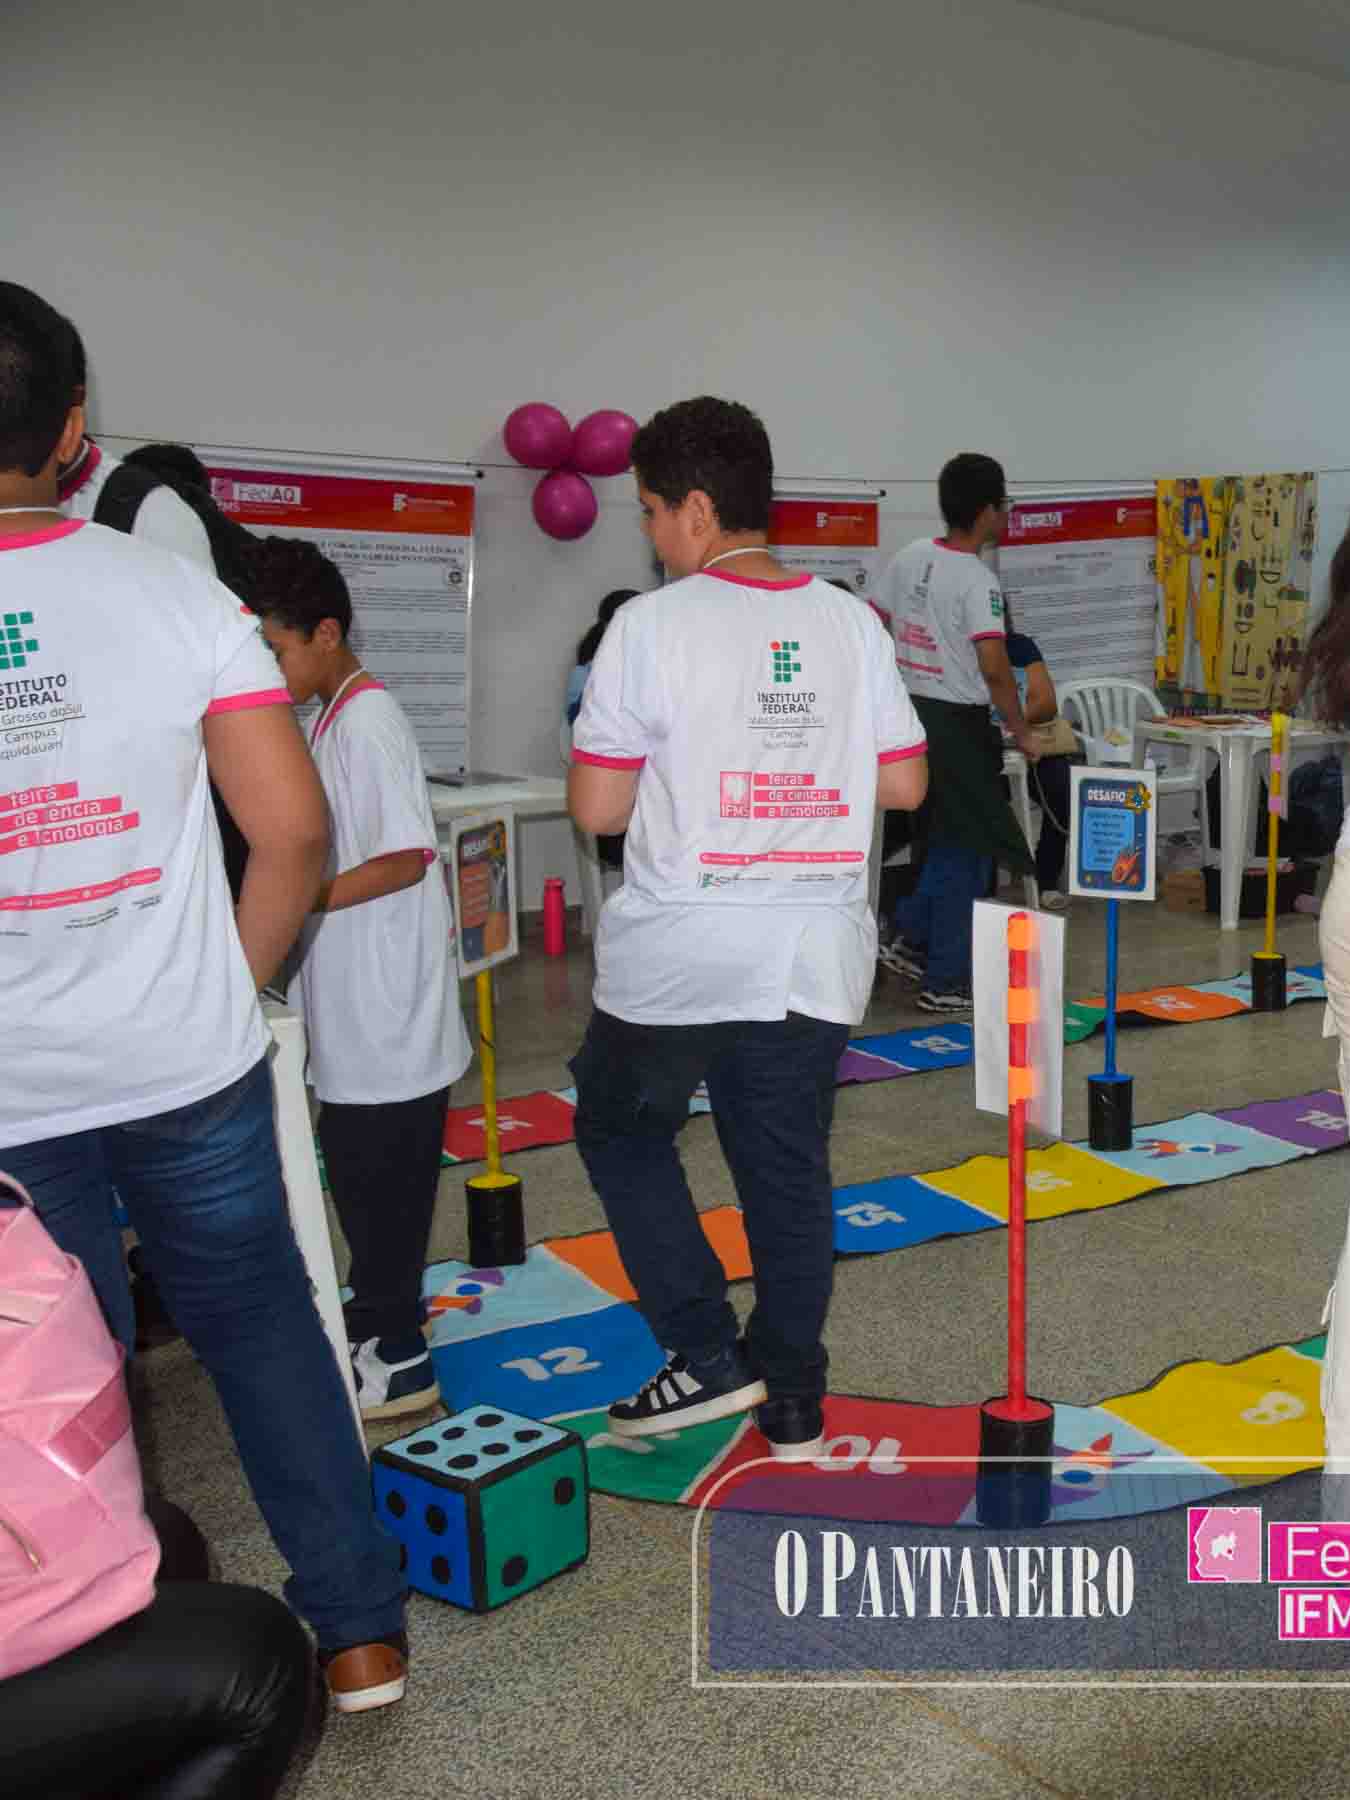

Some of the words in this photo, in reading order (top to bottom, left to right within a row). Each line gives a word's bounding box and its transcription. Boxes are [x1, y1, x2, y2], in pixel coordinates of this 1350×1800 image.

[0, 673, 67, 697] TITUTO
[0, 690, 64, 712] EDERAL
[757, 691, 816, 704] INSTITUTO
[762, 703, 810, 714] FEDERAL
[1, 709, 47, 726] Grosso
[5, 727, 57, 746] Campus
[768, 773, 804, 785] feiras
[15, 810, 38, 828] de
[17, 833, 28, 847] e
[500, 1345, 603, 1382] 12
